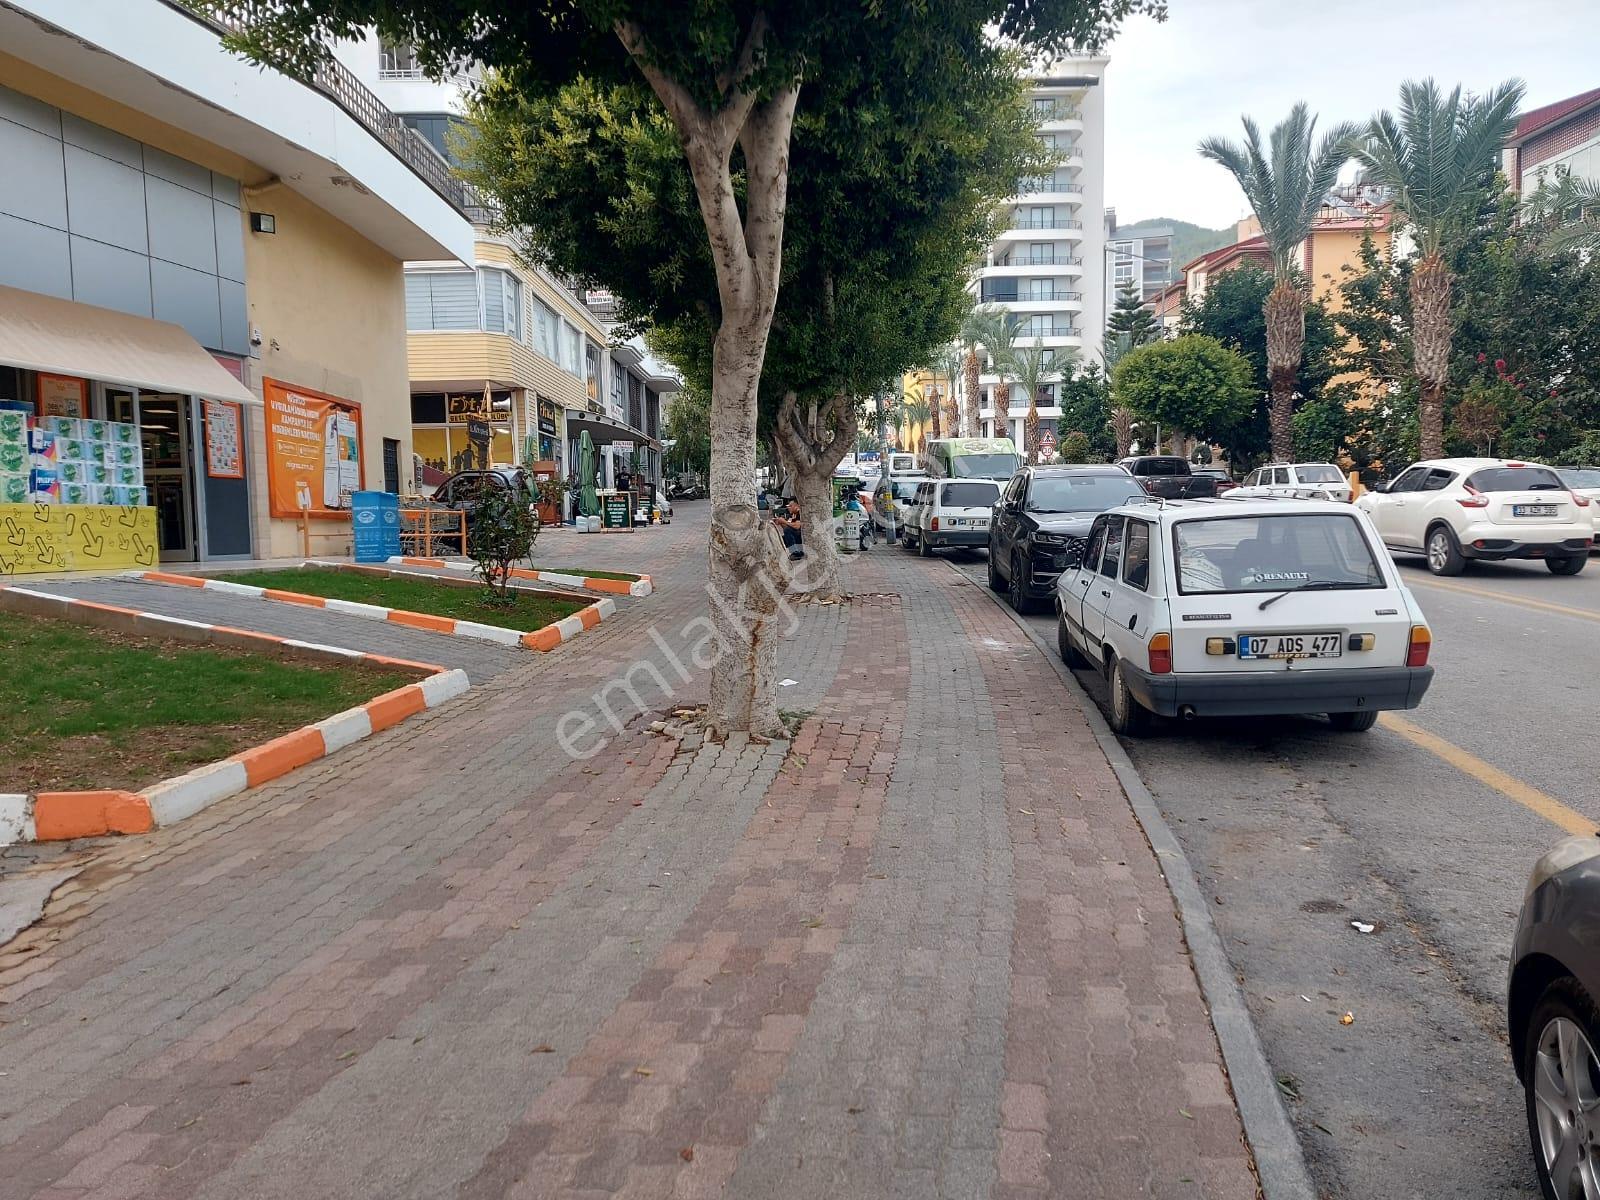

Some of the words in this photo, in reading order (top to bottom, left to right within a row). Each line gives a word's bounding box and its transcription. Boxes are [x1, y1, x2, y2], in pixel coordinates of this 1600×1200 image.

[1264, 572, 1307, 580] RENAULT
[1251, 639, 1268, 654] 07
[1277, 637, 1303, 653] ADS
[1312, 635, 1339, 652] 477
